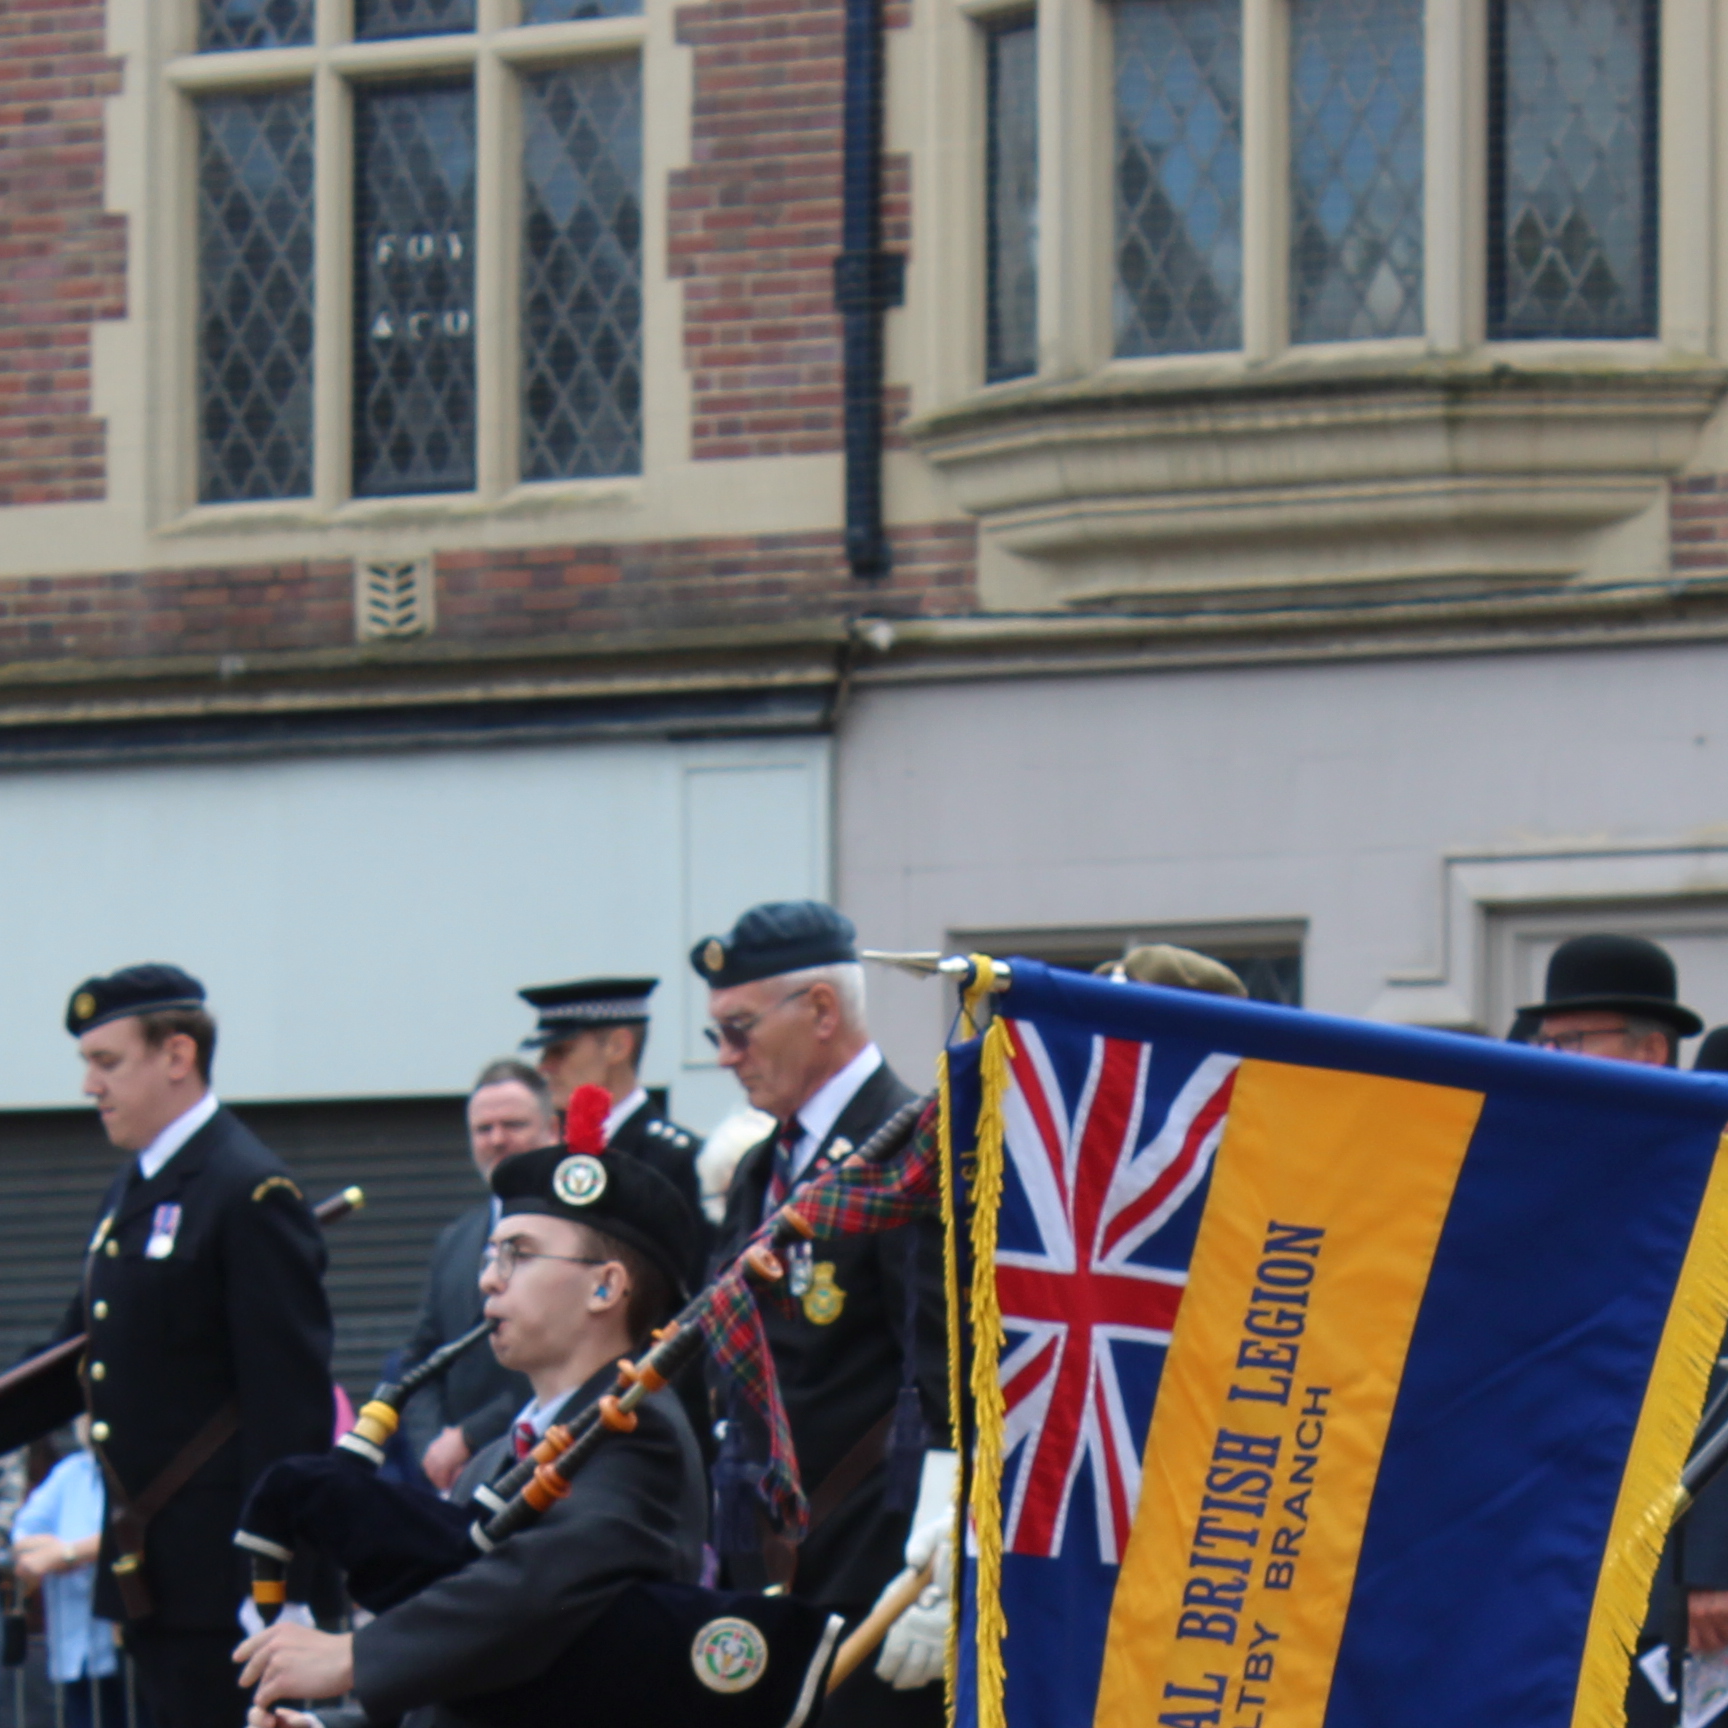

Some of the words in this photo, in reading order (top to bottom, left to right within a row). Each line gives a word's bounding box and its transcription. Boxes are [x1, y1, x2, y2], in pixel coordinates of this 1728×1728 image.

[1227, 1219, 1326, 1406] LEGION
[1175, 1427, 1282, 1646] BRITISH
[1263, 1386, 1332, 1590] BRANCH
